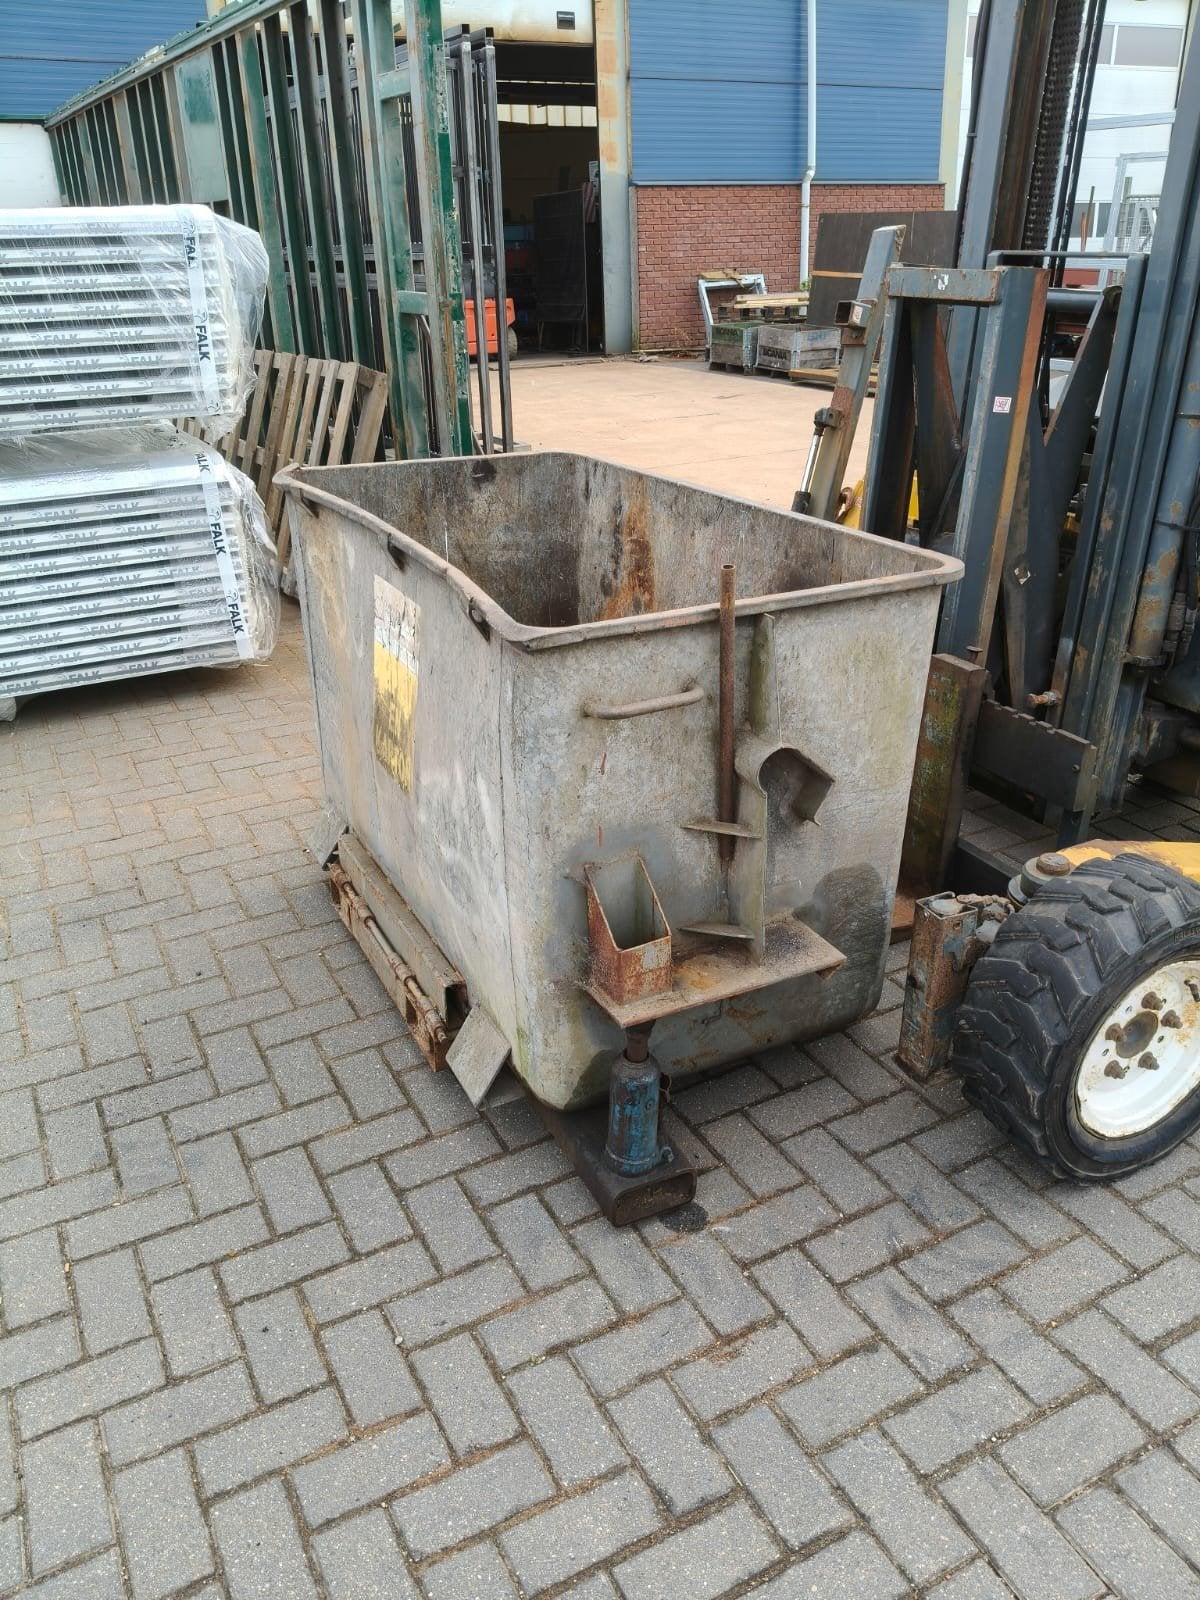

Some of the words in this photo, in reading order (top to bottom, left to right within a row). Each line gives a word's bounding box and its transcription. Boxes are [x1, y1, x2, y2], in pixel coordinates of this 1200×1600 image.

[195, 324, 211, 361] FALK
[194, 452, 211, 473] ALK
[210, 522, 227, 555] FALK
[228, 603, 244, 634] FALK
